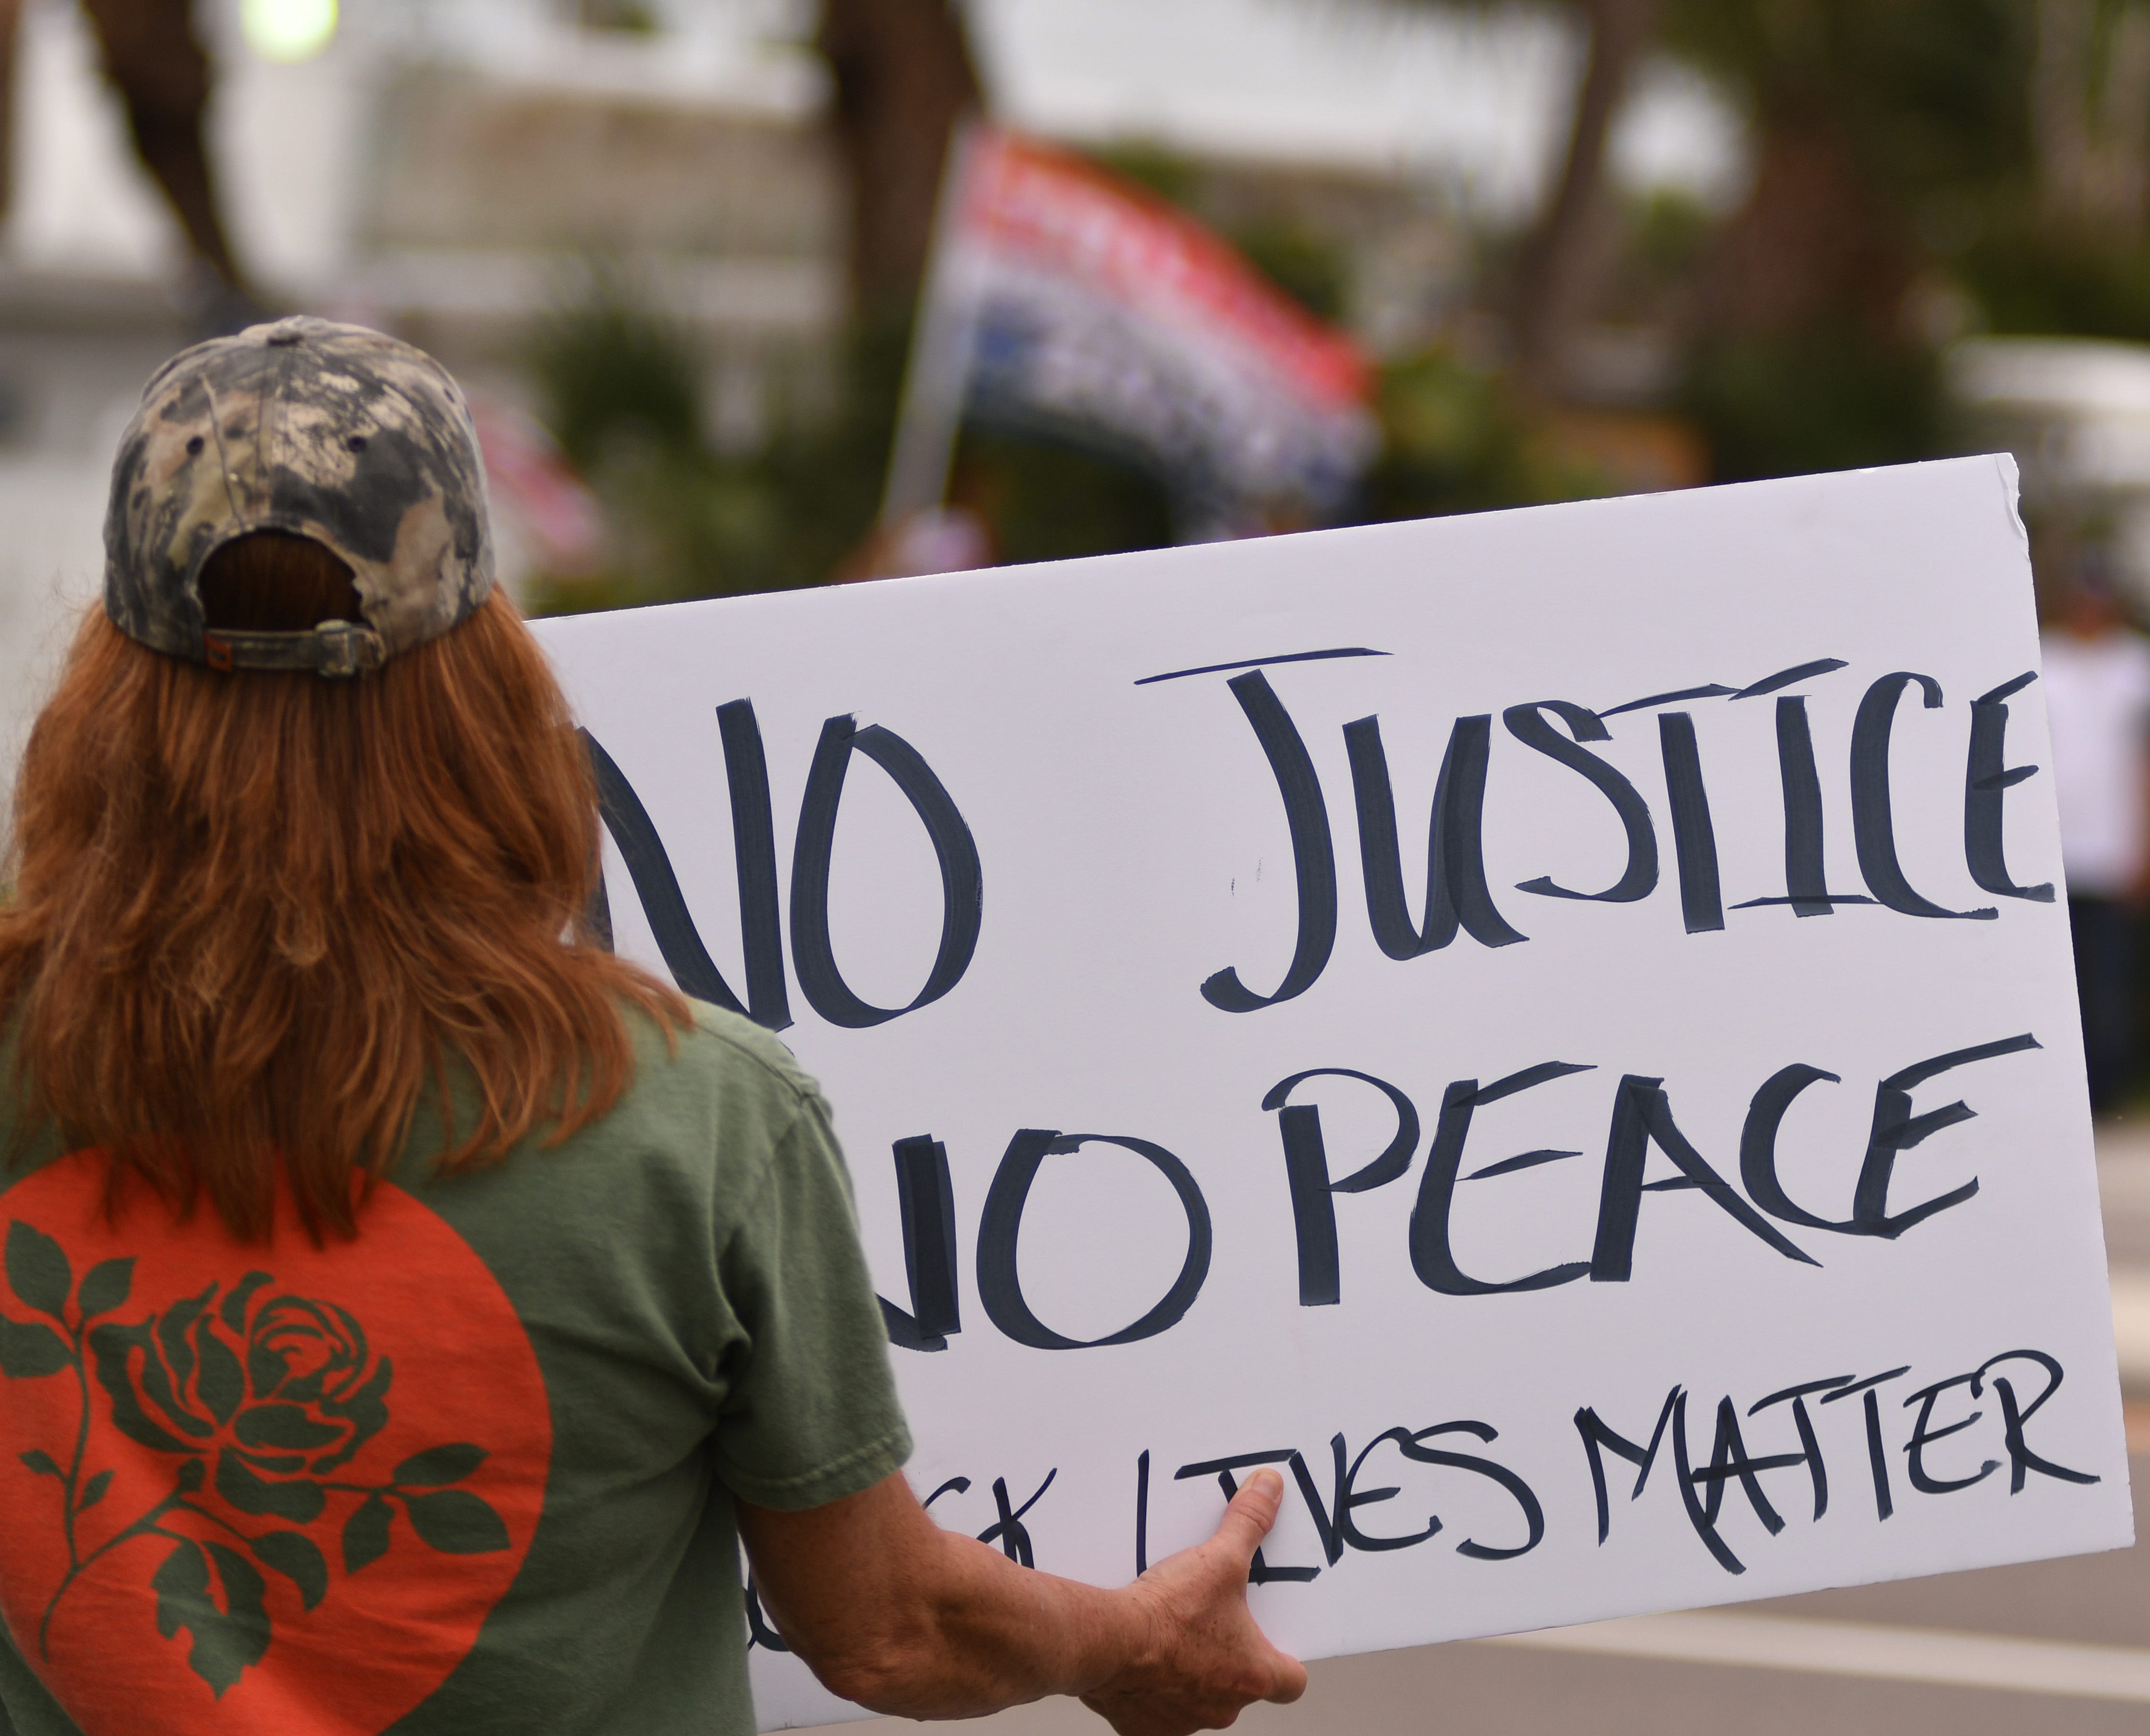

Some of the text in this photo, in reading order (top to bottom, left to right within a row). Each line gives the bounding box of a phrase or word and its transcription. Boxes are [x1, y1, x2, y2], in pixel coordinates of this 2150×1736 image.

[579, 647, 2056, 1029] NO JUSTICE
[1261, 1033, 2043, 1307] PEACE
[1573, 1349, 2101, 1575] MATTER
